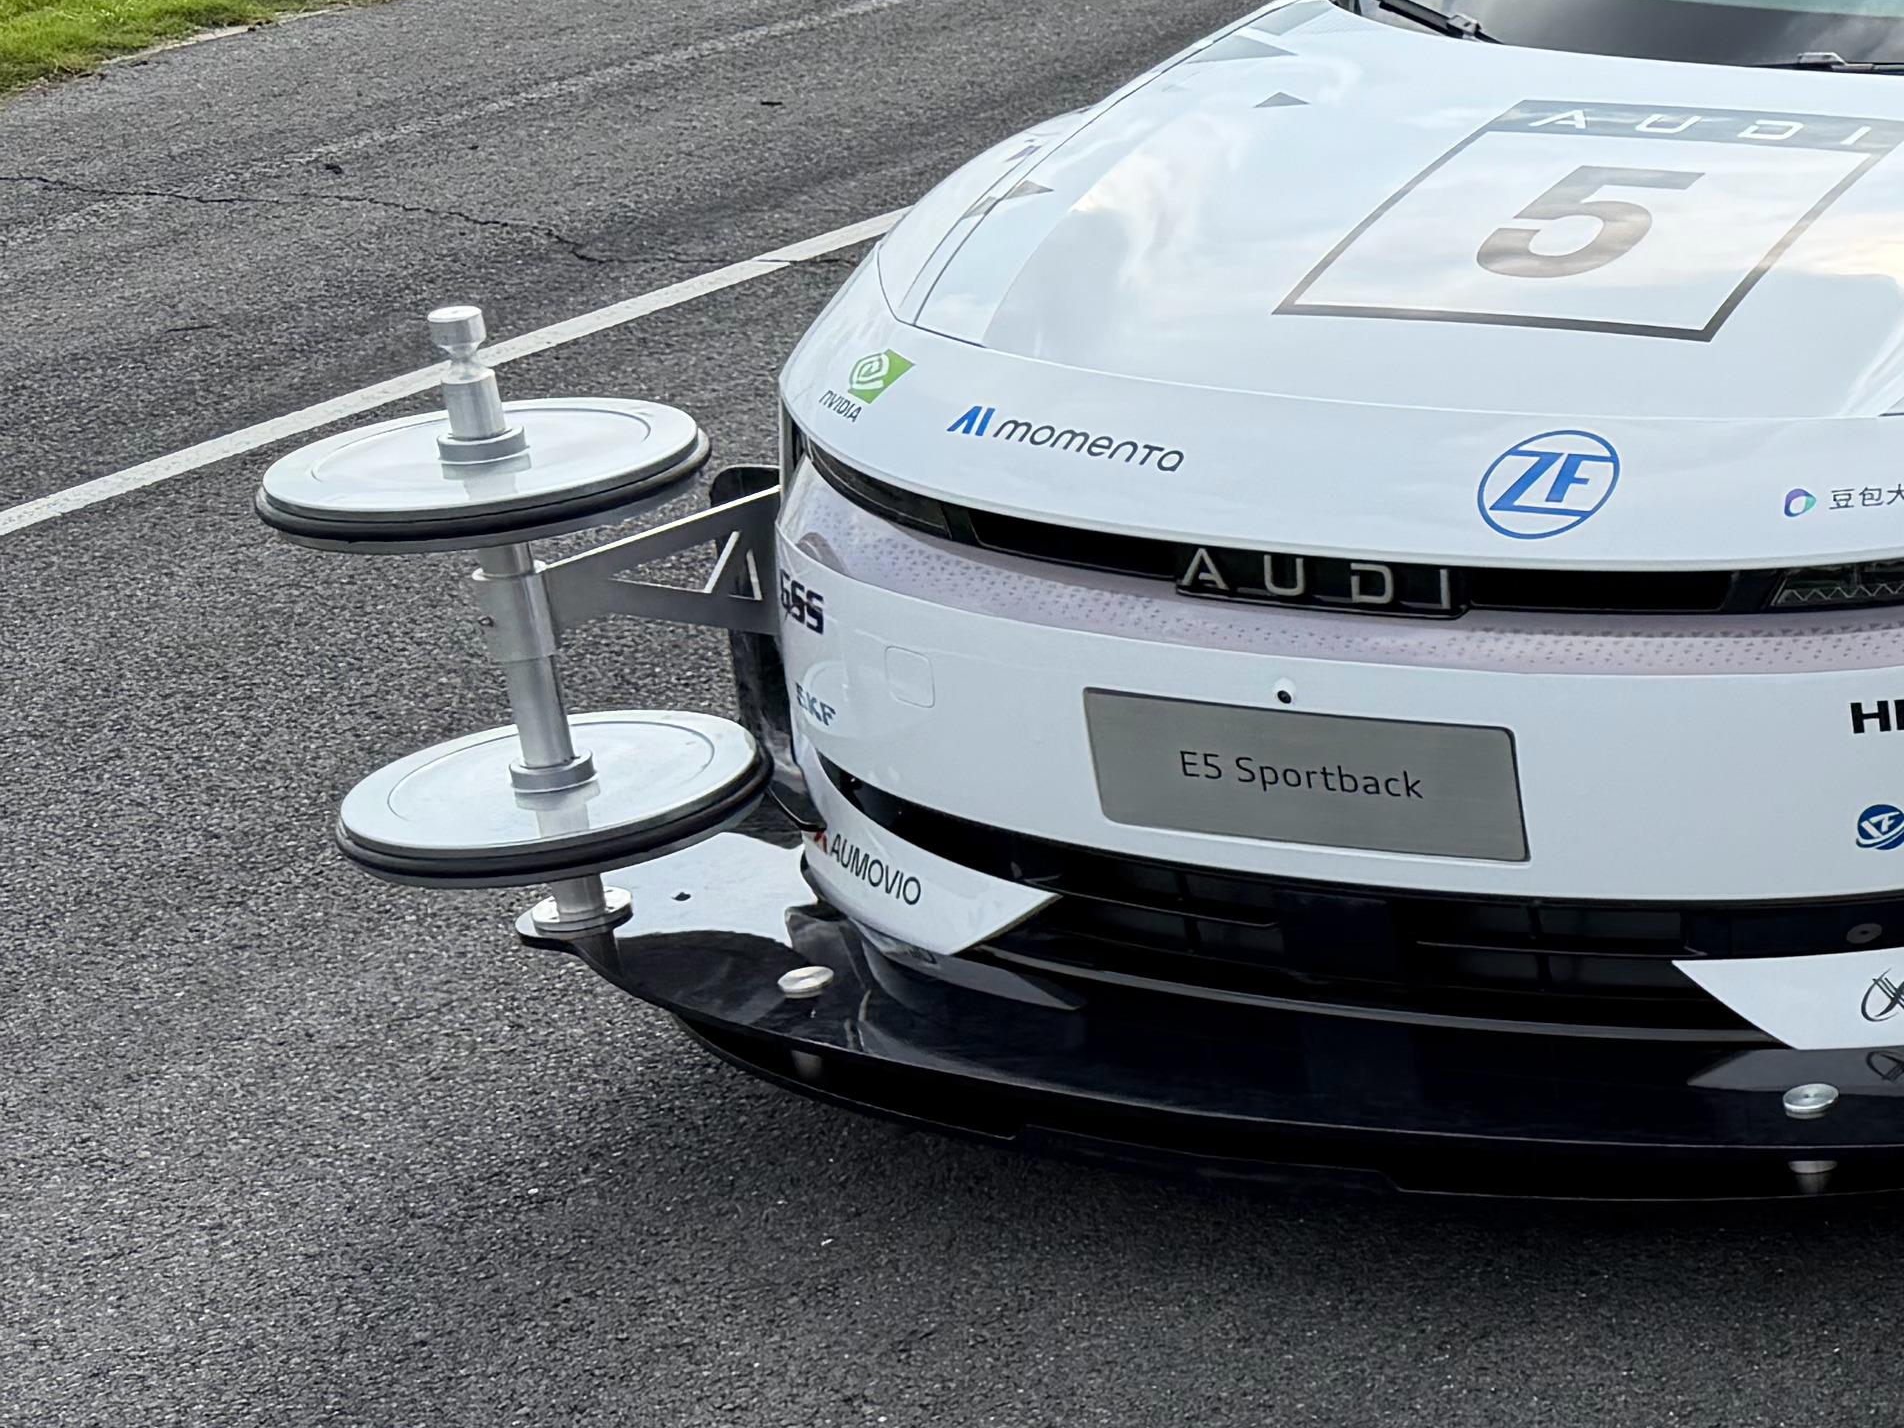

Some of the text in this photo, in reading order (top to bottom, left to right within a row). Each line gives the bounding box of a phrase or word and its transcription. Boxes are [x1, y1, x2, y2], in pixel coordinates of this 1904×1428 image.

[1529, 108, 1872, 147] AUDI
[1477, 165, 1706, 279] 5
[993, 418, 1186, 473] momenta
[1487, 448, 1617, 518] ZF
[1181, 547, 1451, 611] AUDI
[1180, 750, 1424, 801] E5 Sportback
[829, 833, 922, 906] AUMOVIO
